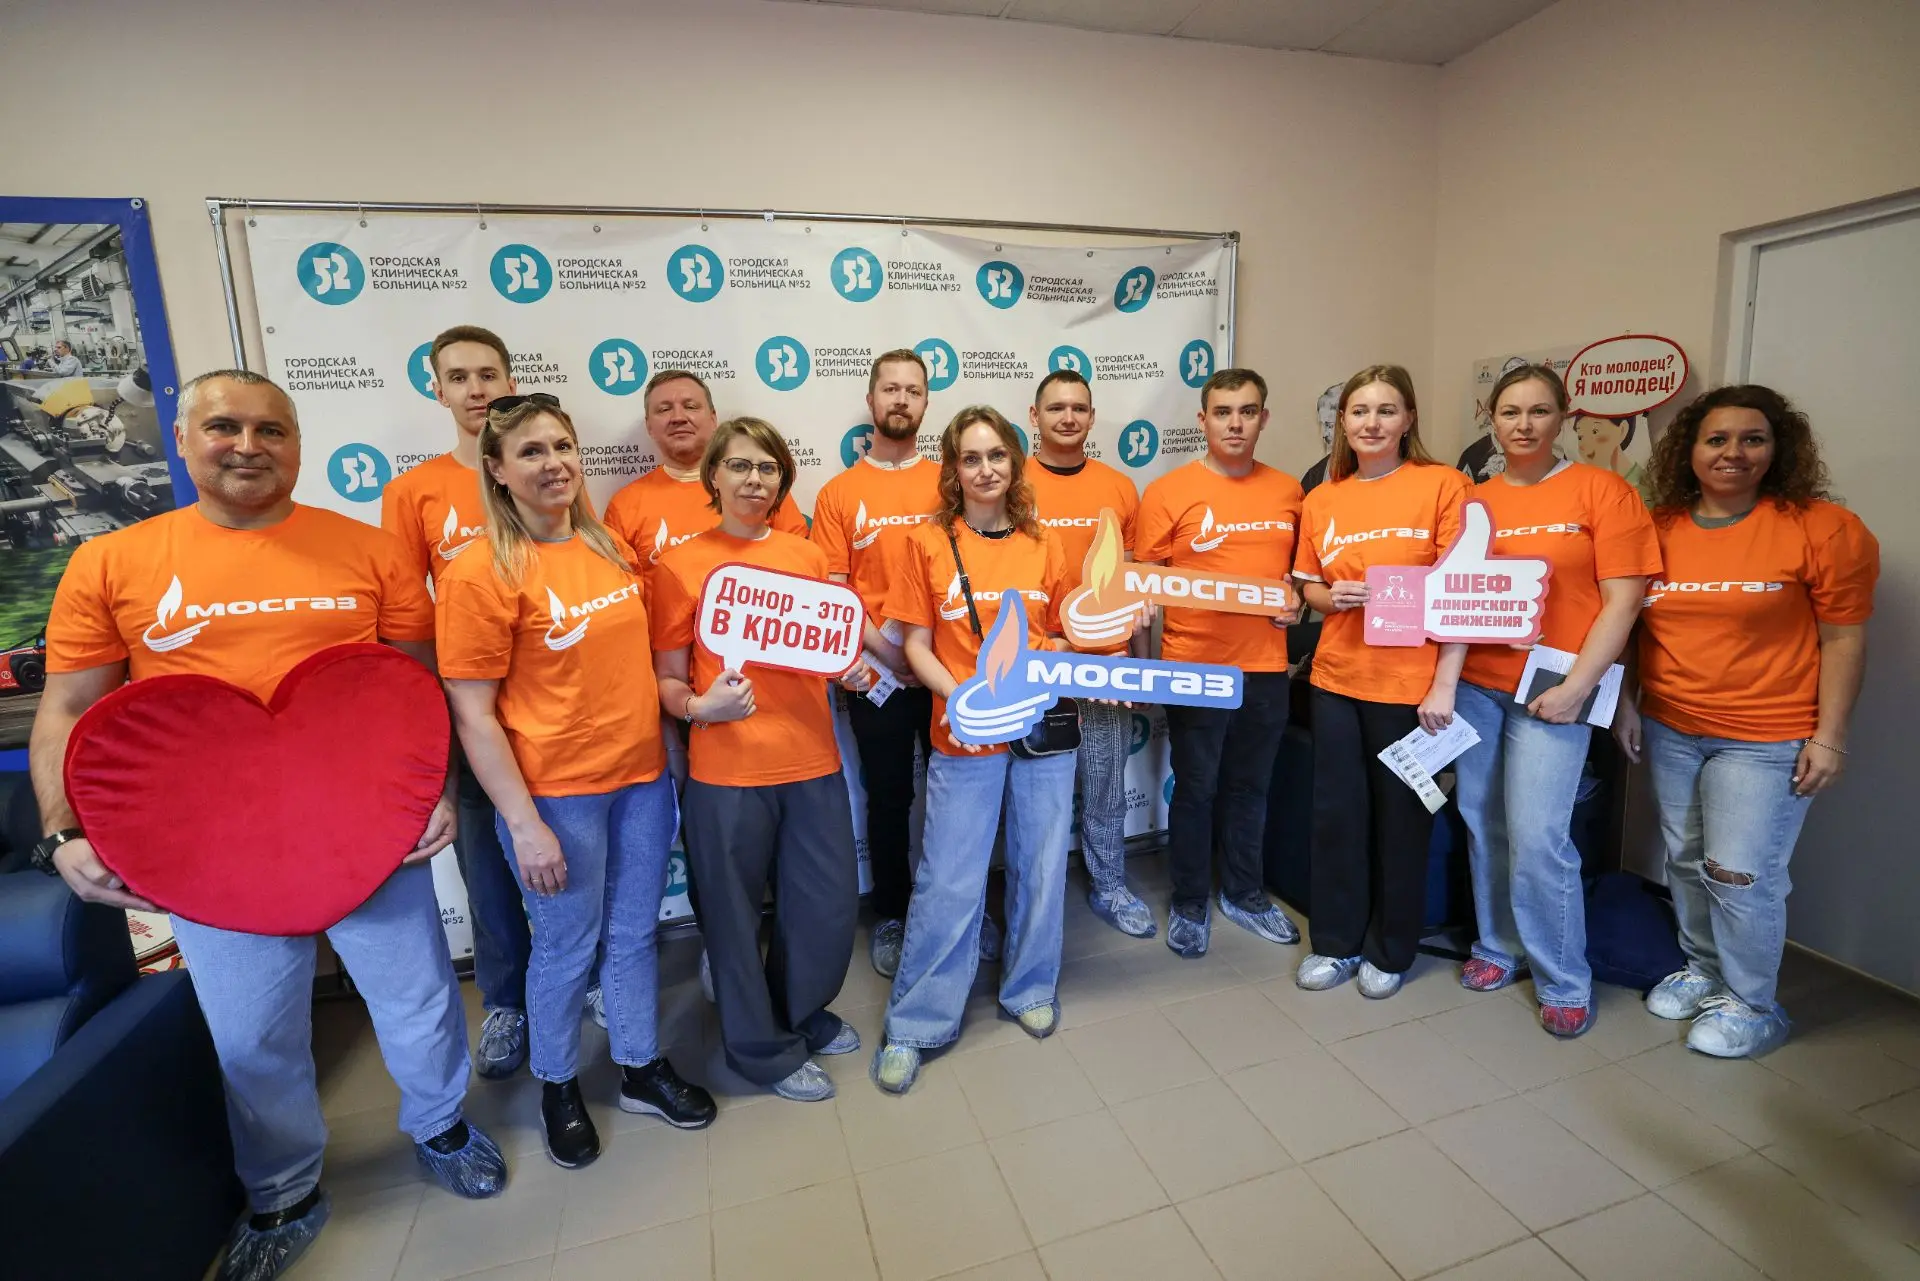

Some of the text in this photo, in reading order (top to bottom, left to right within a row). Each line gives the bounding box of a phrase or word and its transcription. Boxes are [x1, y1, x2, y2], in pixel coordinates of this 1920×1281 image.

[370, 257, 440, 267] ГОРОДСКАЯ
[557, 259, 622, 268] ГОРОДСКАЯ
[729, 258, 788, 268] ГОРОДСКАЯ
[887, 261, 942, 271] ГОРОДСКАЯ
[371, 269, 458, 278] КЛИНИЧЕСКАЯ
[558, 270, 638, 279] КЛИНИЧЕСКАЯ
[730, 269, 803, 278] КЛИНИЧЕСКАЯ
[888, 272, 955, 281] КЛИНИЧЕСКАЯ
[1160, 271, 1206, 281] ГОРОДСКАЯ
[373, 280, 467, 291] БОЛЬНИЦА №52
[560, 281, 646, 291] БОЛЬНИЦА №52
[730, 280, 811, 289] БОЛЬНИЦА №52
[1031, 276, 1083, 286] ГОРОДСКАЯ
[1157, 279, 1216, 290] КЛИНИЧЕСКАЯ
[888, 282, 961, 292] БОЛЬНИЦА №52
[1028, 285, 1093, 295] КЛИНИЧЕСКАЯ
[1027, 292, 1075, 304] БОЛЬНИЦА
[1156, 288, 1204, 300] БОЛЬНИЦА
[652, 350, 713, 359] ГОРОДСКАЯ
[814, 348, 871, 357] ГОРОДСКАЯ
[962, 351, 1016, 360] ГОРОДСКАЯ
[285, 357, 356, 368] ГОРОДСКАЯ
[815, 358, 876, 367] КЛИНИЧЕСК
[1094, 354, 1145, 363] ГОРОДСКАЯ
[653, 360, 728, 370] КЛИНИЧЕСКАЯ
[962, 361, 1028, 370] КЛИНИЧЕСКАЯ
[1096, 362, 1158, 372] КЛИНИЧЕСКАЯ
[1580, 362, 1602, 377] Кто
[1606, 354, 1674, 374] молодец?
[287, 368, 375, 379] КЛИНИЧЕСКАЯ
[816, 368, 869, 378] БОЛЬНИЦА
[963, 371, 1012, 380] БОЛЬНИЦА
[1097, 371, 1144, 381] БОЛЬНИЦА
[288, 379, 385, 391] БОЛЬНИЦА №52
[1575, 372, 1675, 396] Я молодец!
[800, 458, 821, 467] №52
[1444, 573, 1512, 594] ШЕФ
[716, 576, 794, 616] Донор
[818, 601, 855, 623] это
[1431, 599, 1528, 612] ДОНОРСКОГО
[1440, 615, 1523, 628] ДВИЖЕНИЯ
[742, 614, 852, 657] крови!
